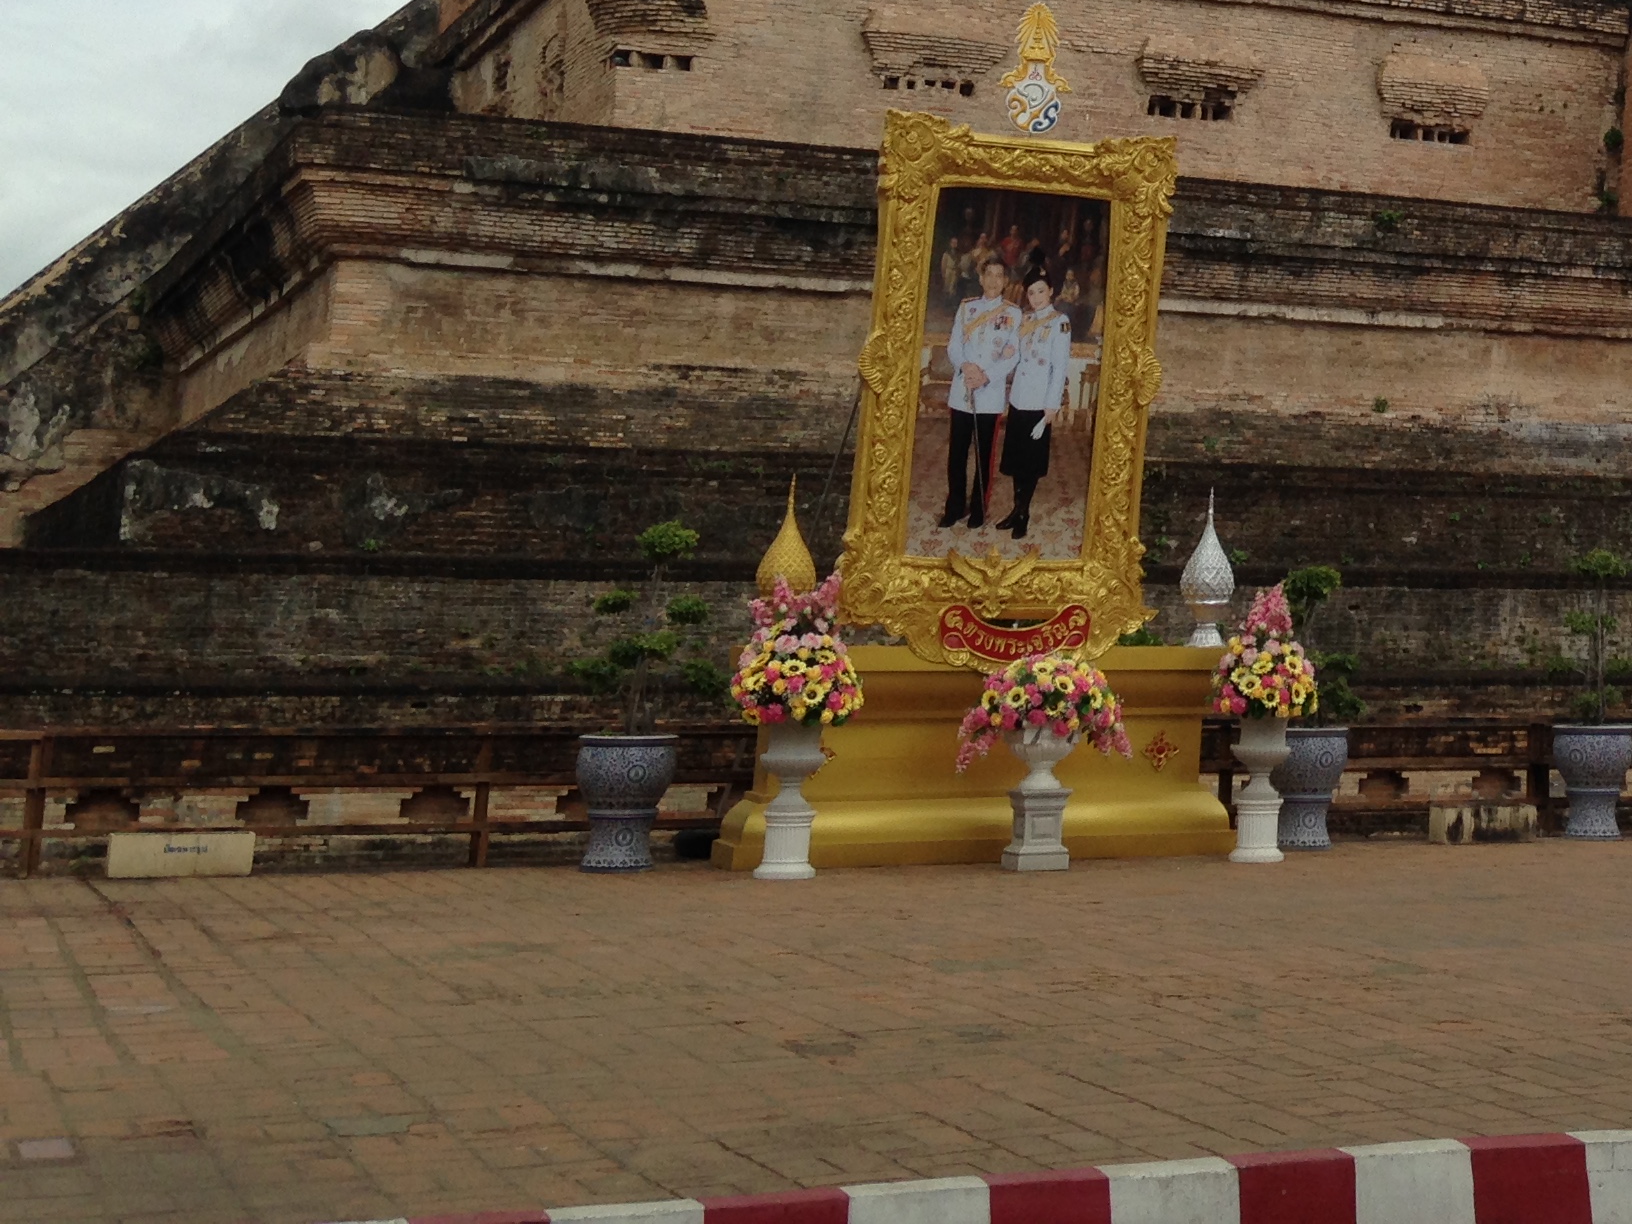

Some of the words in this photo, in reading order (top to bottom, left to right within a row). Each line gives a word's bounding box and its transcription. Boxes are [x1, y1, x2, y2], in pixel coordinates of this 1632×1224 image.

[963, 621, 1069, 655] ทรงพระเจริญ
